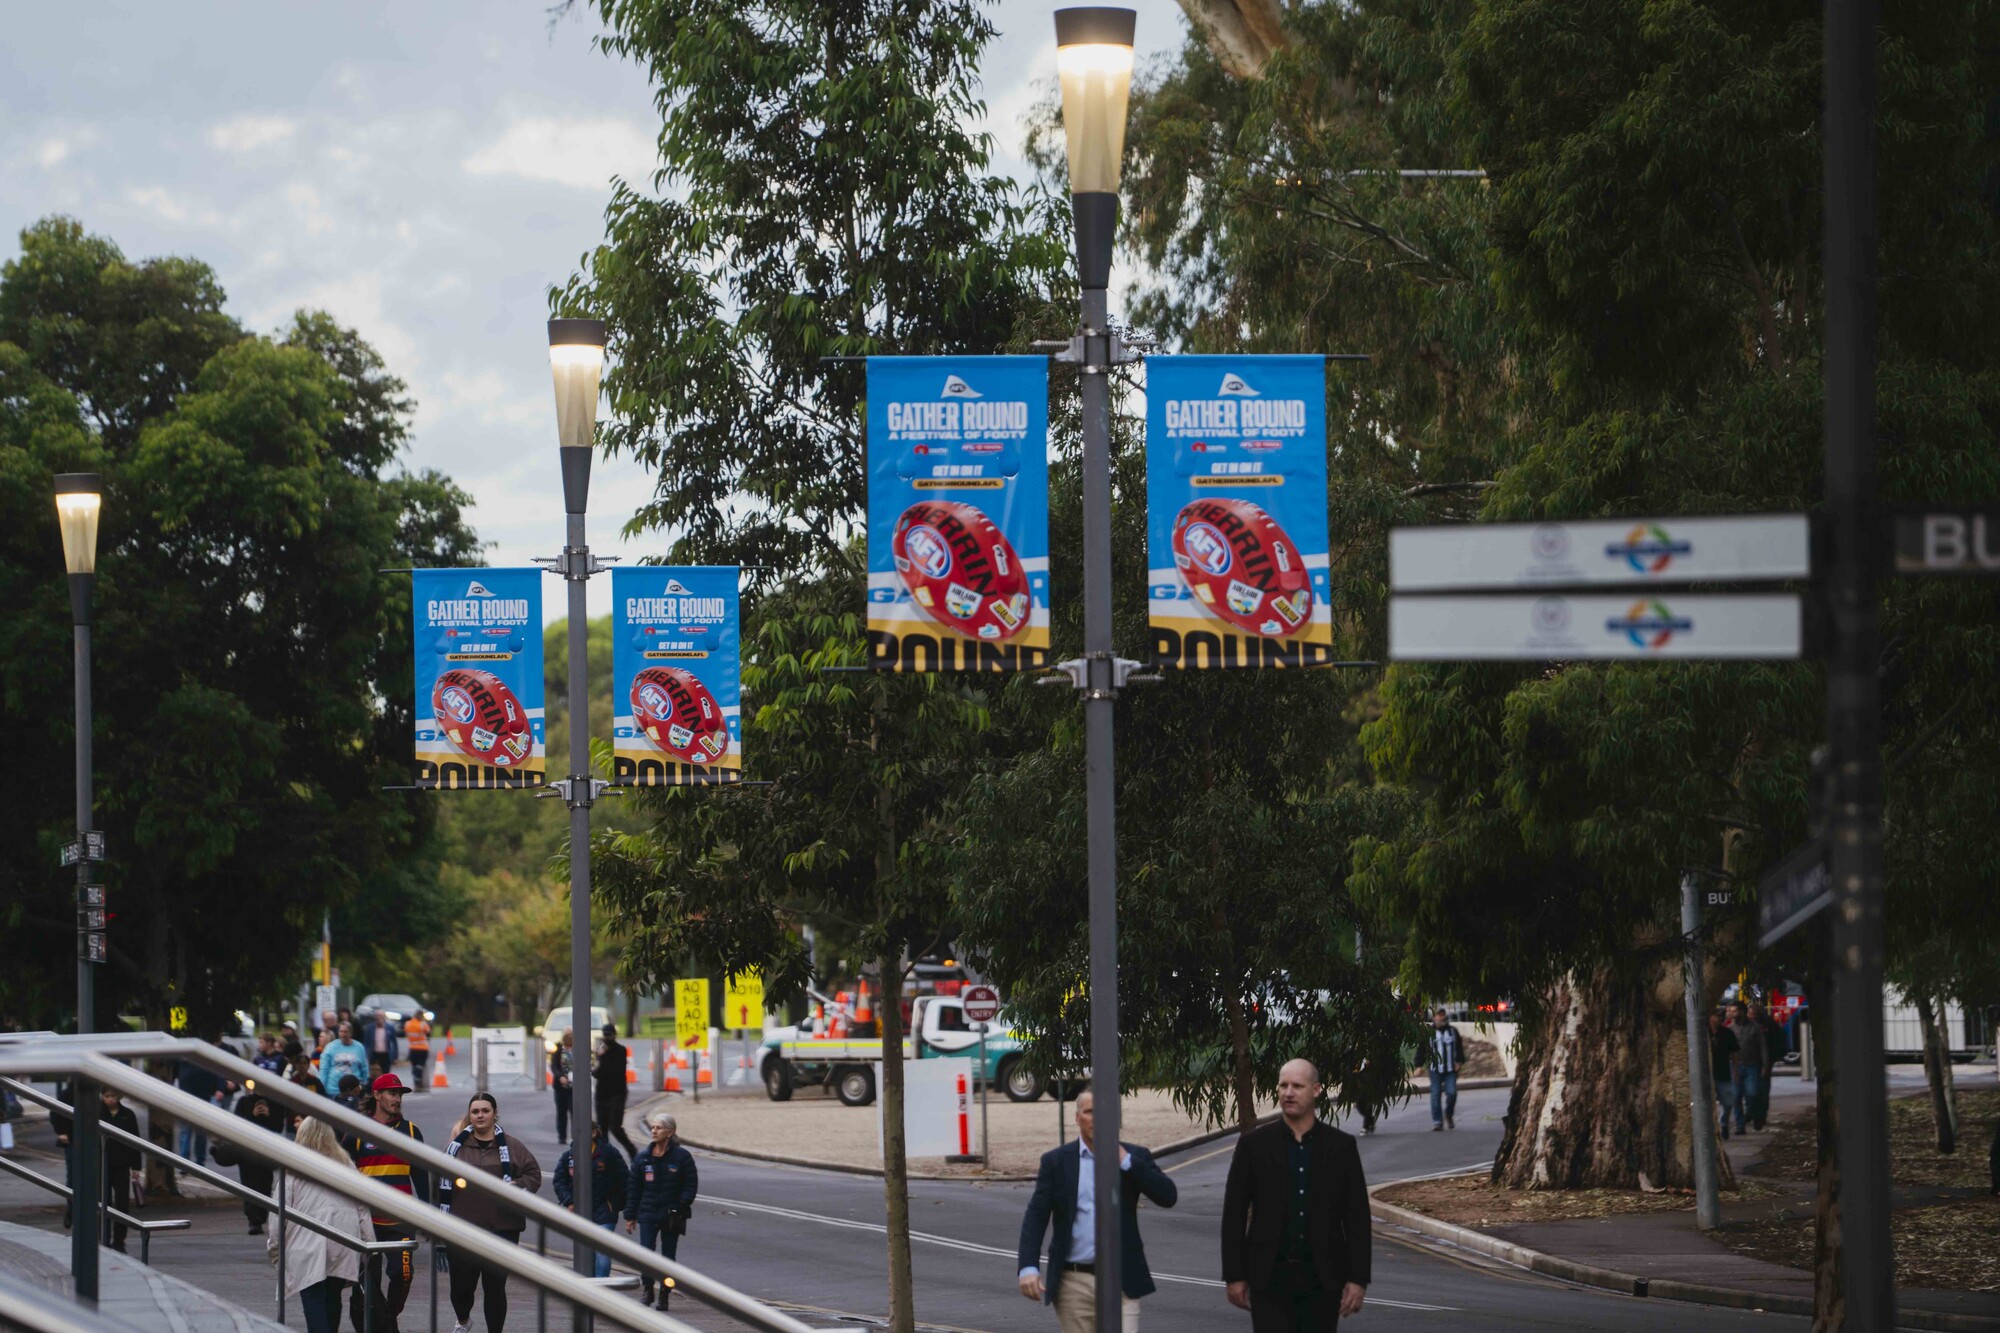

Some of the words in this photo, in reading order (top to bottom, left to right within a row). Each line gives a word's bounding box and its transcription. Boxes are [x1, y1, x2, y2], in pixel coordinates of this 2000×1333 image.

[888, 402, 960, 431] GATHER
[962, 402, 1028, 431] ROUND
[1166, 400, 1238, 428] GATHER
[1240, 400, 1306, 428] ROUND
[888, 432, 899, 440] A
[901, 432, 962, 440] FESTIVAL
[964, 431, 982, 440] OF
[984, 430, 1028, 440] FOOTY
[1166, 429, 1176, 438] A
[1178, 429, 1240, 437] FESTIVAL
[1242, 428, 1260, 436] OF
[1262, 428, 1305, 436] FOOTY
[932, 465, 949, 476] GET
[950, 465, 960, 476] IN
[974, 465, 984, 476] IT
[1211, 462, 1228, 474] GET
[1228, 462, 1239, 474] IN
[1253, 462, 1262, 473] IT
[906, 531, 946, 576] AFL
[1185, 528, 1224, 573] AFL
[428, 600, 479, 620] GATHER
[482, 599, 528, 620] ROUND
[626, 598, 677, 618] GATHER
[680, 598, 724, 618] ROUND
[461, 644, 472, 652] GET
[442, 690, 469, 722] AFL
[641, 688, 667, 718] AFL
[683, 982, 700, 993] AO
[683, 996, 700, 1006] 1-8
[684, 1008, 701, 1020] AO
[971, 1010, 993, 1018] ENTRY
[678, 1022, 706, 1032] 11-14
